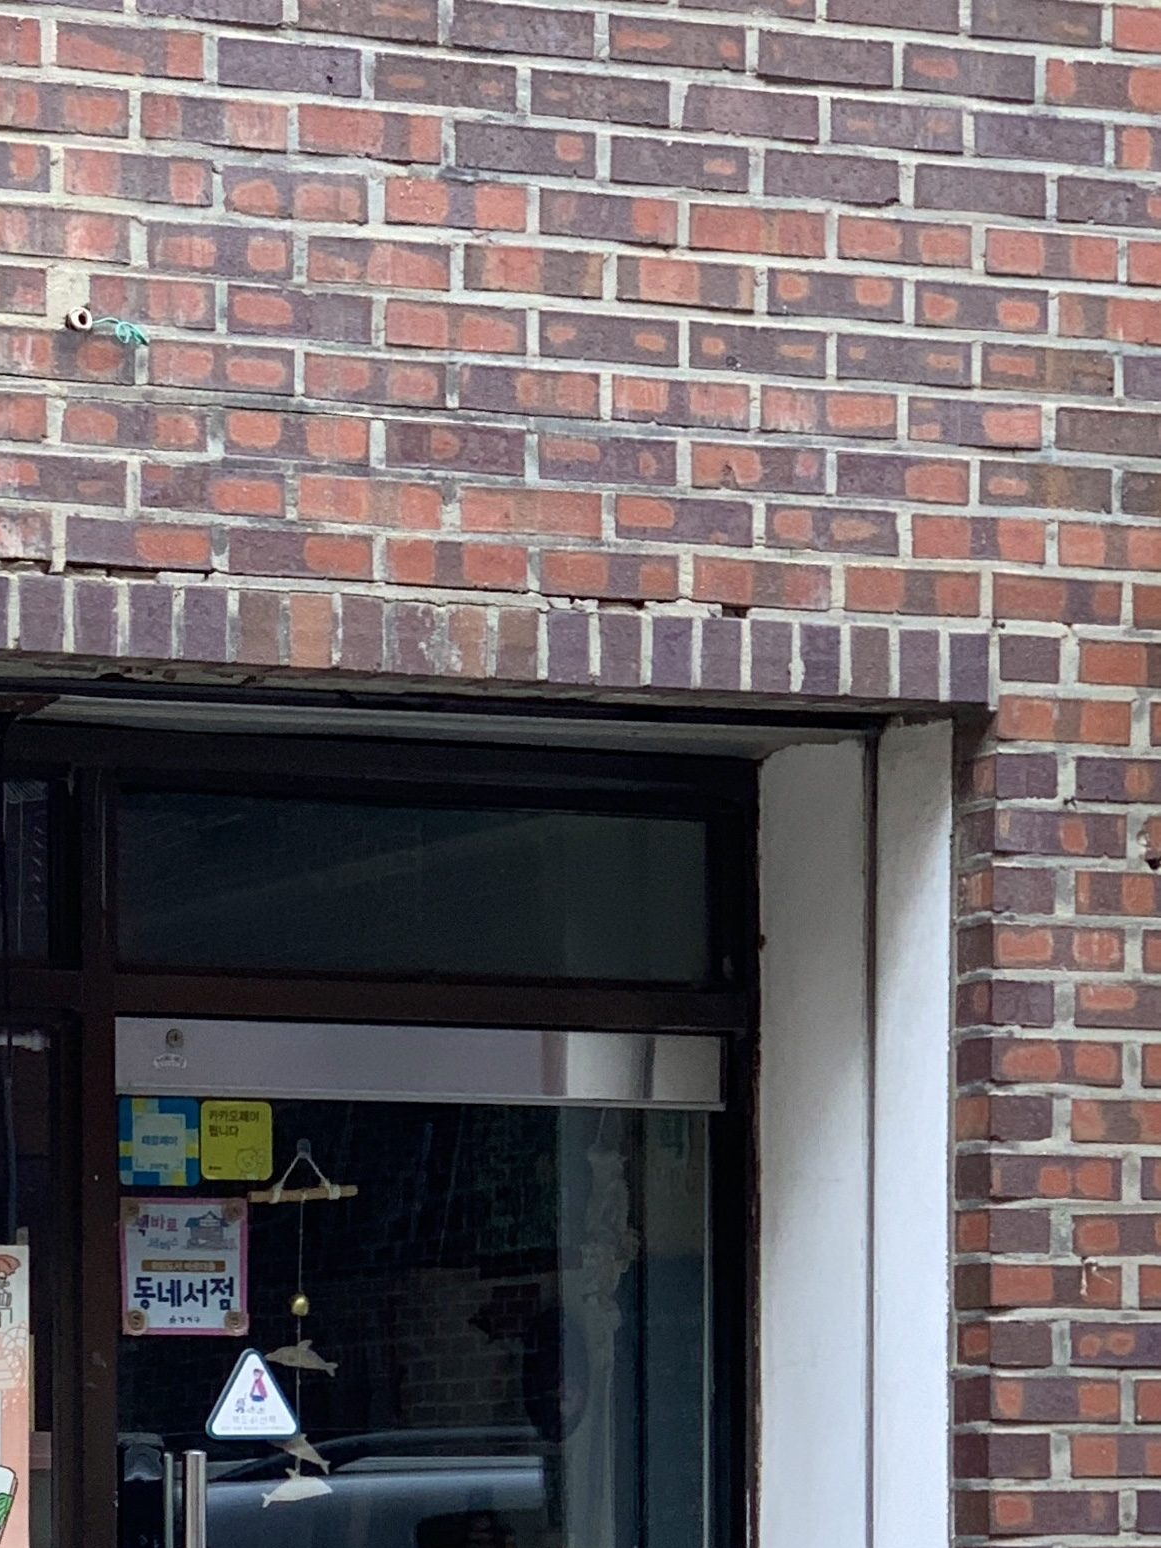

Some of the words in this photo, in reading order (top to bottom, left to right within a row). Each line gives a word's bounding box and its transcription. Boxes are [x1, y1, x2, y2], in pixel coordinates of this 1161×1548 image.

[208, 1109, 260, 1123] 카카오페이
[208, 1124, 239, 1138] 됩니다
[132, 1275, 235, 1311] 동네서점
